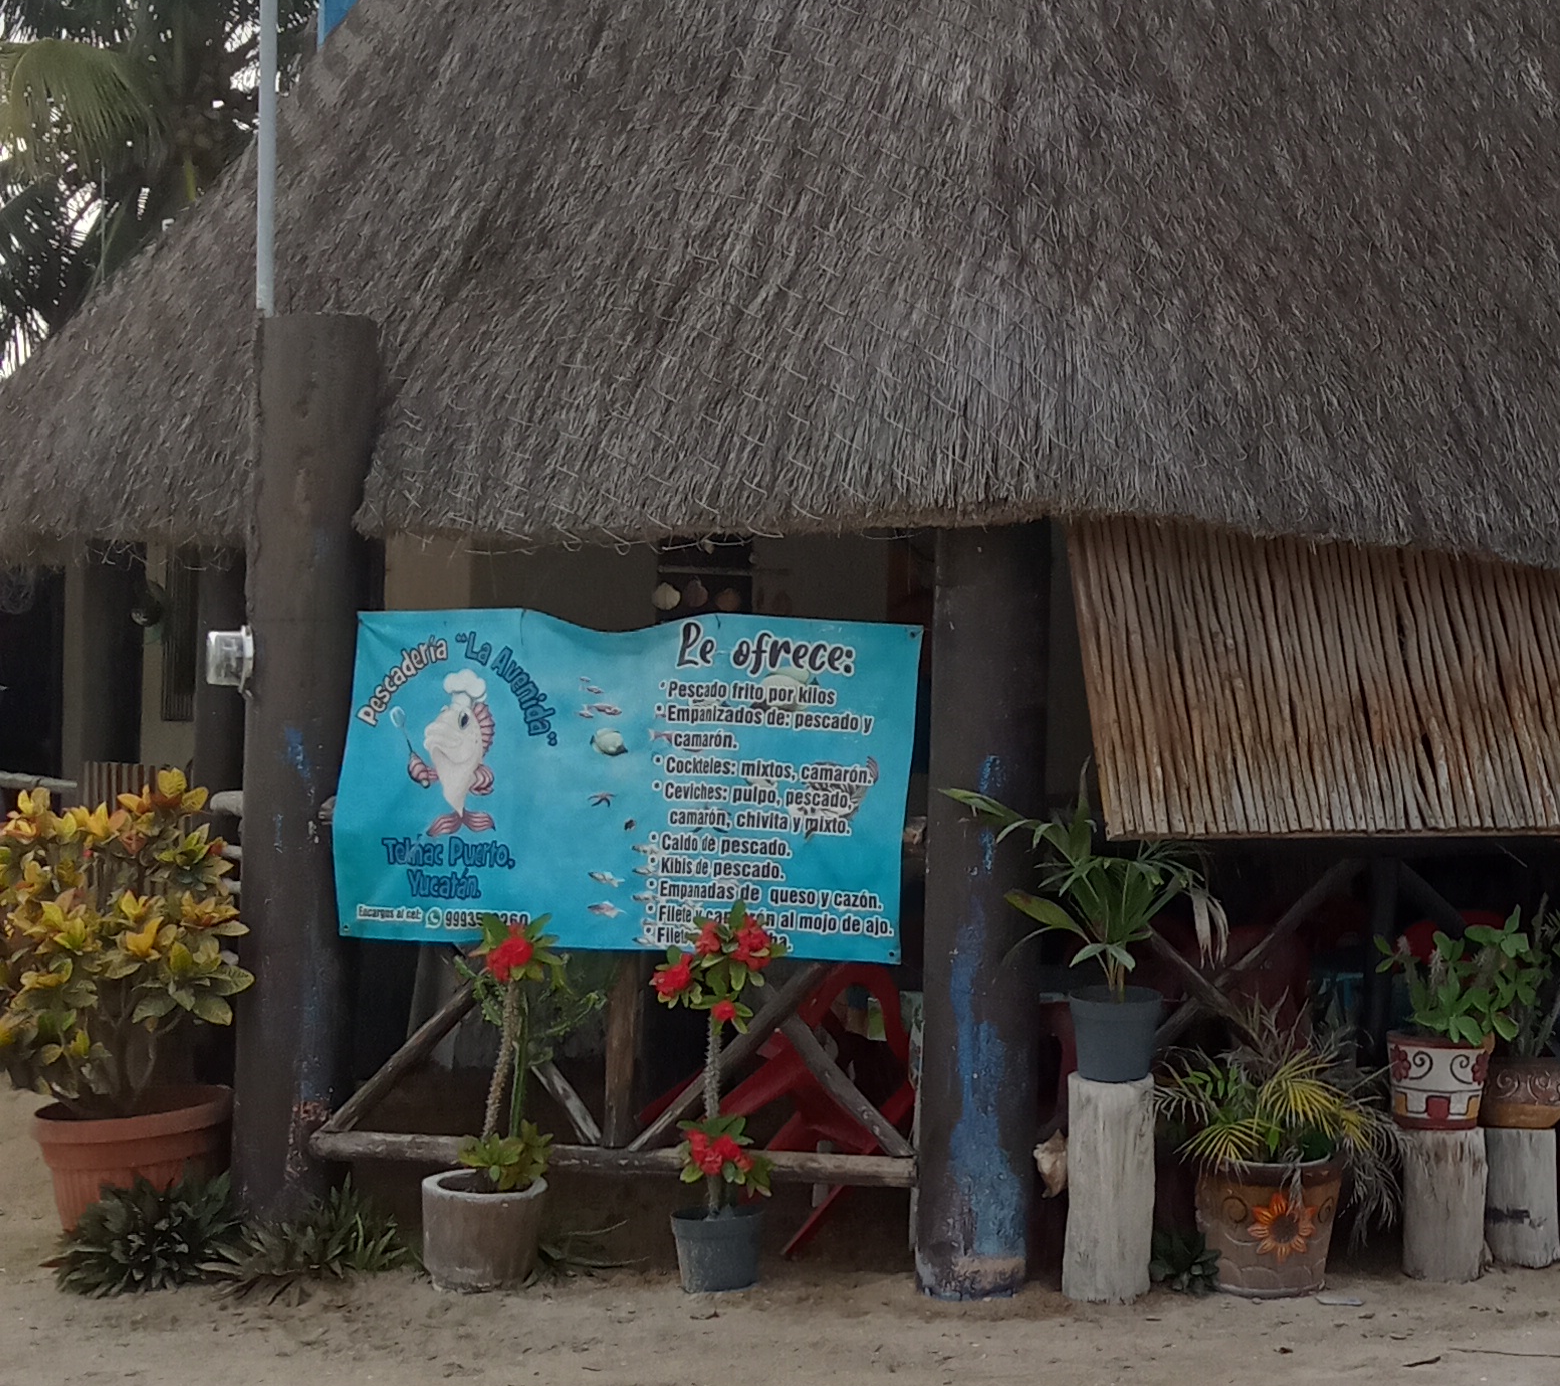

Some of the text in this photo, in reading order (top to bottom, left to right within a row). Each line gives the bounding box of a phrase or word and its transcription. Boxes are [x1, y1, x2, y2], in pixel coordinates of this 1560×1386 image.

[676, 622, 854, 675] Le ofrece:
[356, 635, 449, 727] Pescadería
[668, 681, 835, 705] Pescado frito por kilos
[667, 705, 873, 734] Empanizados de: pescado y
[674, 729, 738, 749] camarón.
[741, 759, 796, 781] mixtos,
[801, 762, 873, 784] camarón.
[665, 782, 852, 810] Ceviches: pulpo, pescado,
[670, 807, 851, 835] camarón, chivita y mixto.
[449, 836, 516, 870] Puerto,
[662, 833, 791, 857] Caldo de pescado.
[660, 857, 784, 880] Kibis de pescado.
[407, 868, 481, 900] Yucatán.
[660, 880, 882, 910] Empanadas de queso y cazón.
[658, 904, 693, 923] Filete
[780, 911, 794, 928] al
[799, 914, 837, 932] mojo
[842, 915, 861, 932] de
[866, 919, 894, 937] ajo.
